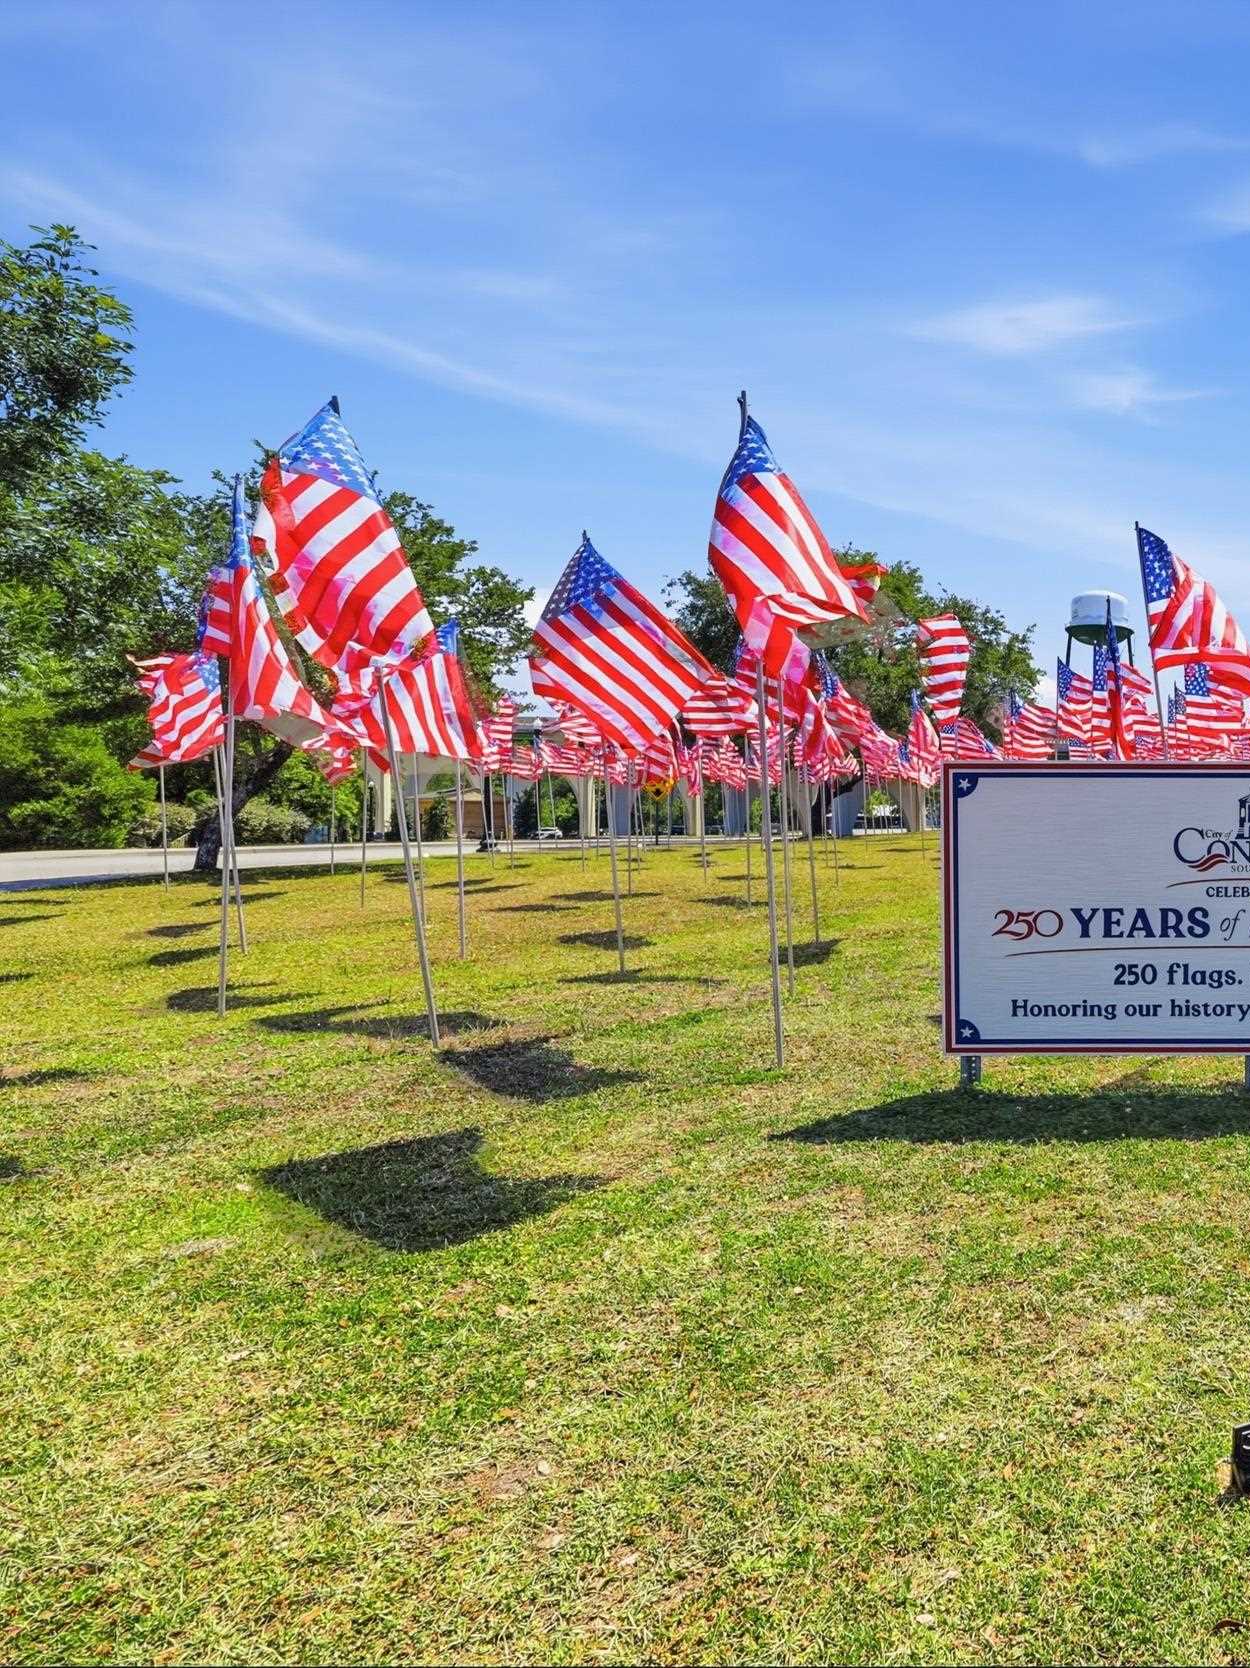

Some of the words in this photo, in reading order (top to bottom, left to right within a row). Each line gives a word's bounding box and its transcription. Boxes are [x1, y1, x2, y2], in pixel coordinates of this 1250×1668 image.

[1205, 829, 1222, 842] City
[1224, 829, 1234, 841] of
[992, 909, 1063, 941] 250
[1071, 908, 1210, 938] YEARS
[1220, 909, 1246, 941] of
[1114, 963, 1158, 985] 250
[1167, 963, 1243, 989] flags.
[1011, 999, 1117, 1020] Honoring
[1124, 1004, 1162, 1017] our
